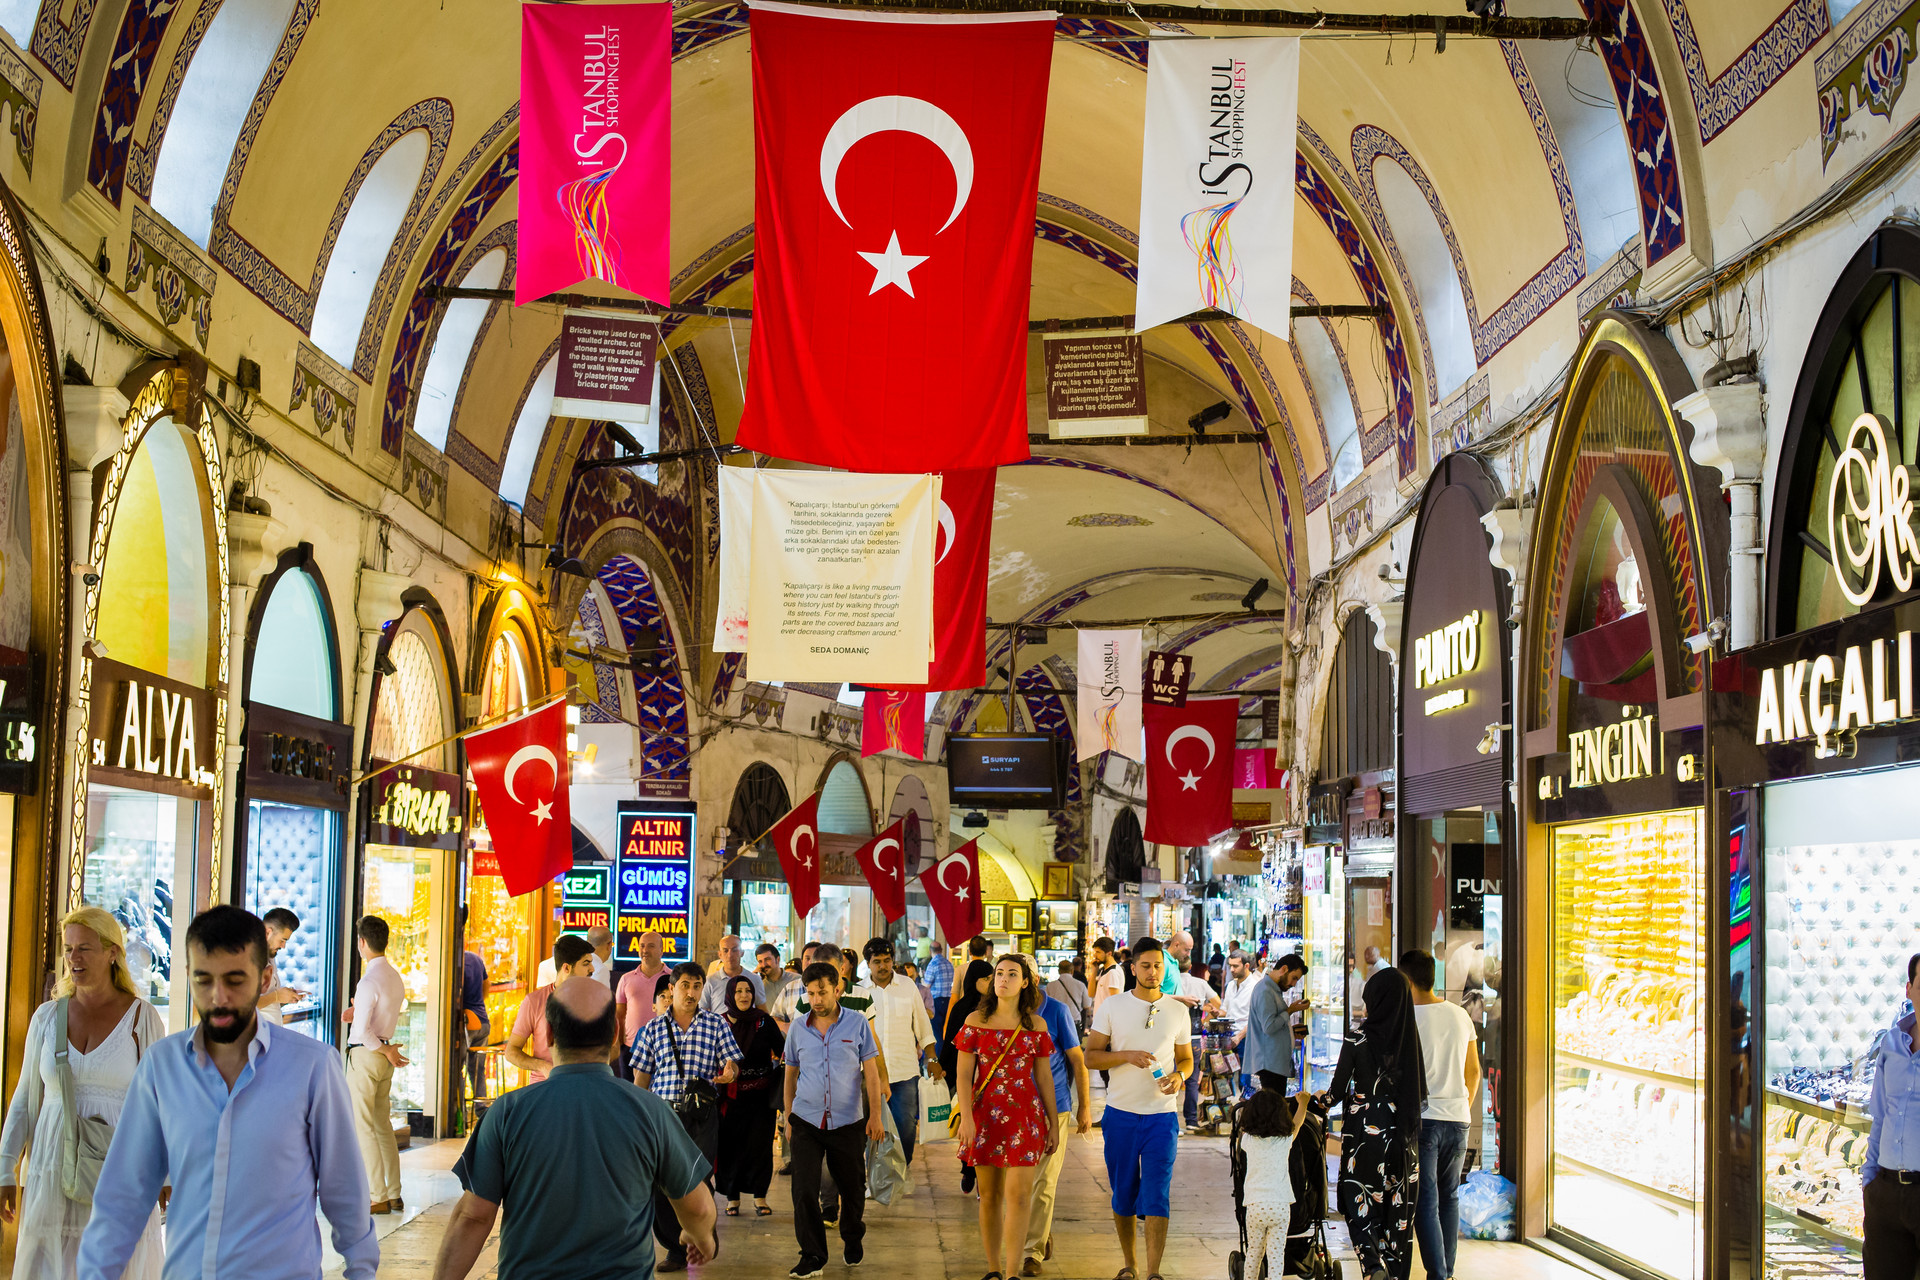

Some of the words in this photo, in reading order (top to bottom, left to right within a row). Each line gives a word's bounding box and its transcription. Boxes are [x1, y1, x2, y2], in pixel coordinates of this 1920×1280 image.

[607, 25, 619, 127] SHOPPINGFEST
[1232, 59, 1246, 159] SHOPPINGFEST
[611, 328, 627, 337] used
[620, 358, 645, 366] arches,
[575, 371, 582, 380] by
[585, 372, 618, 382] plastering
[578, 380, 598, 388] bricks
[870, 502, 899, 510] görkemli
[852, 583, 869, 591] living
[833, 646, 869, 654] DOMANİÇ
[1152, 683, 1179, 695] WC
[1756, 630, 1912, 759] AKÇALI
[117, 680, 197, 783] ALYA
[1569, 705, 1653, 788] ENGİN
[631, 821, 681, 836] ALTIN
[626, 840, 684, 855] ALINIR
[622, 867, 686, 889] GÜMÜŞ
[624, 890, 683, 905] ALINIR
[618, 917, 687, 933] PIRLANTA
